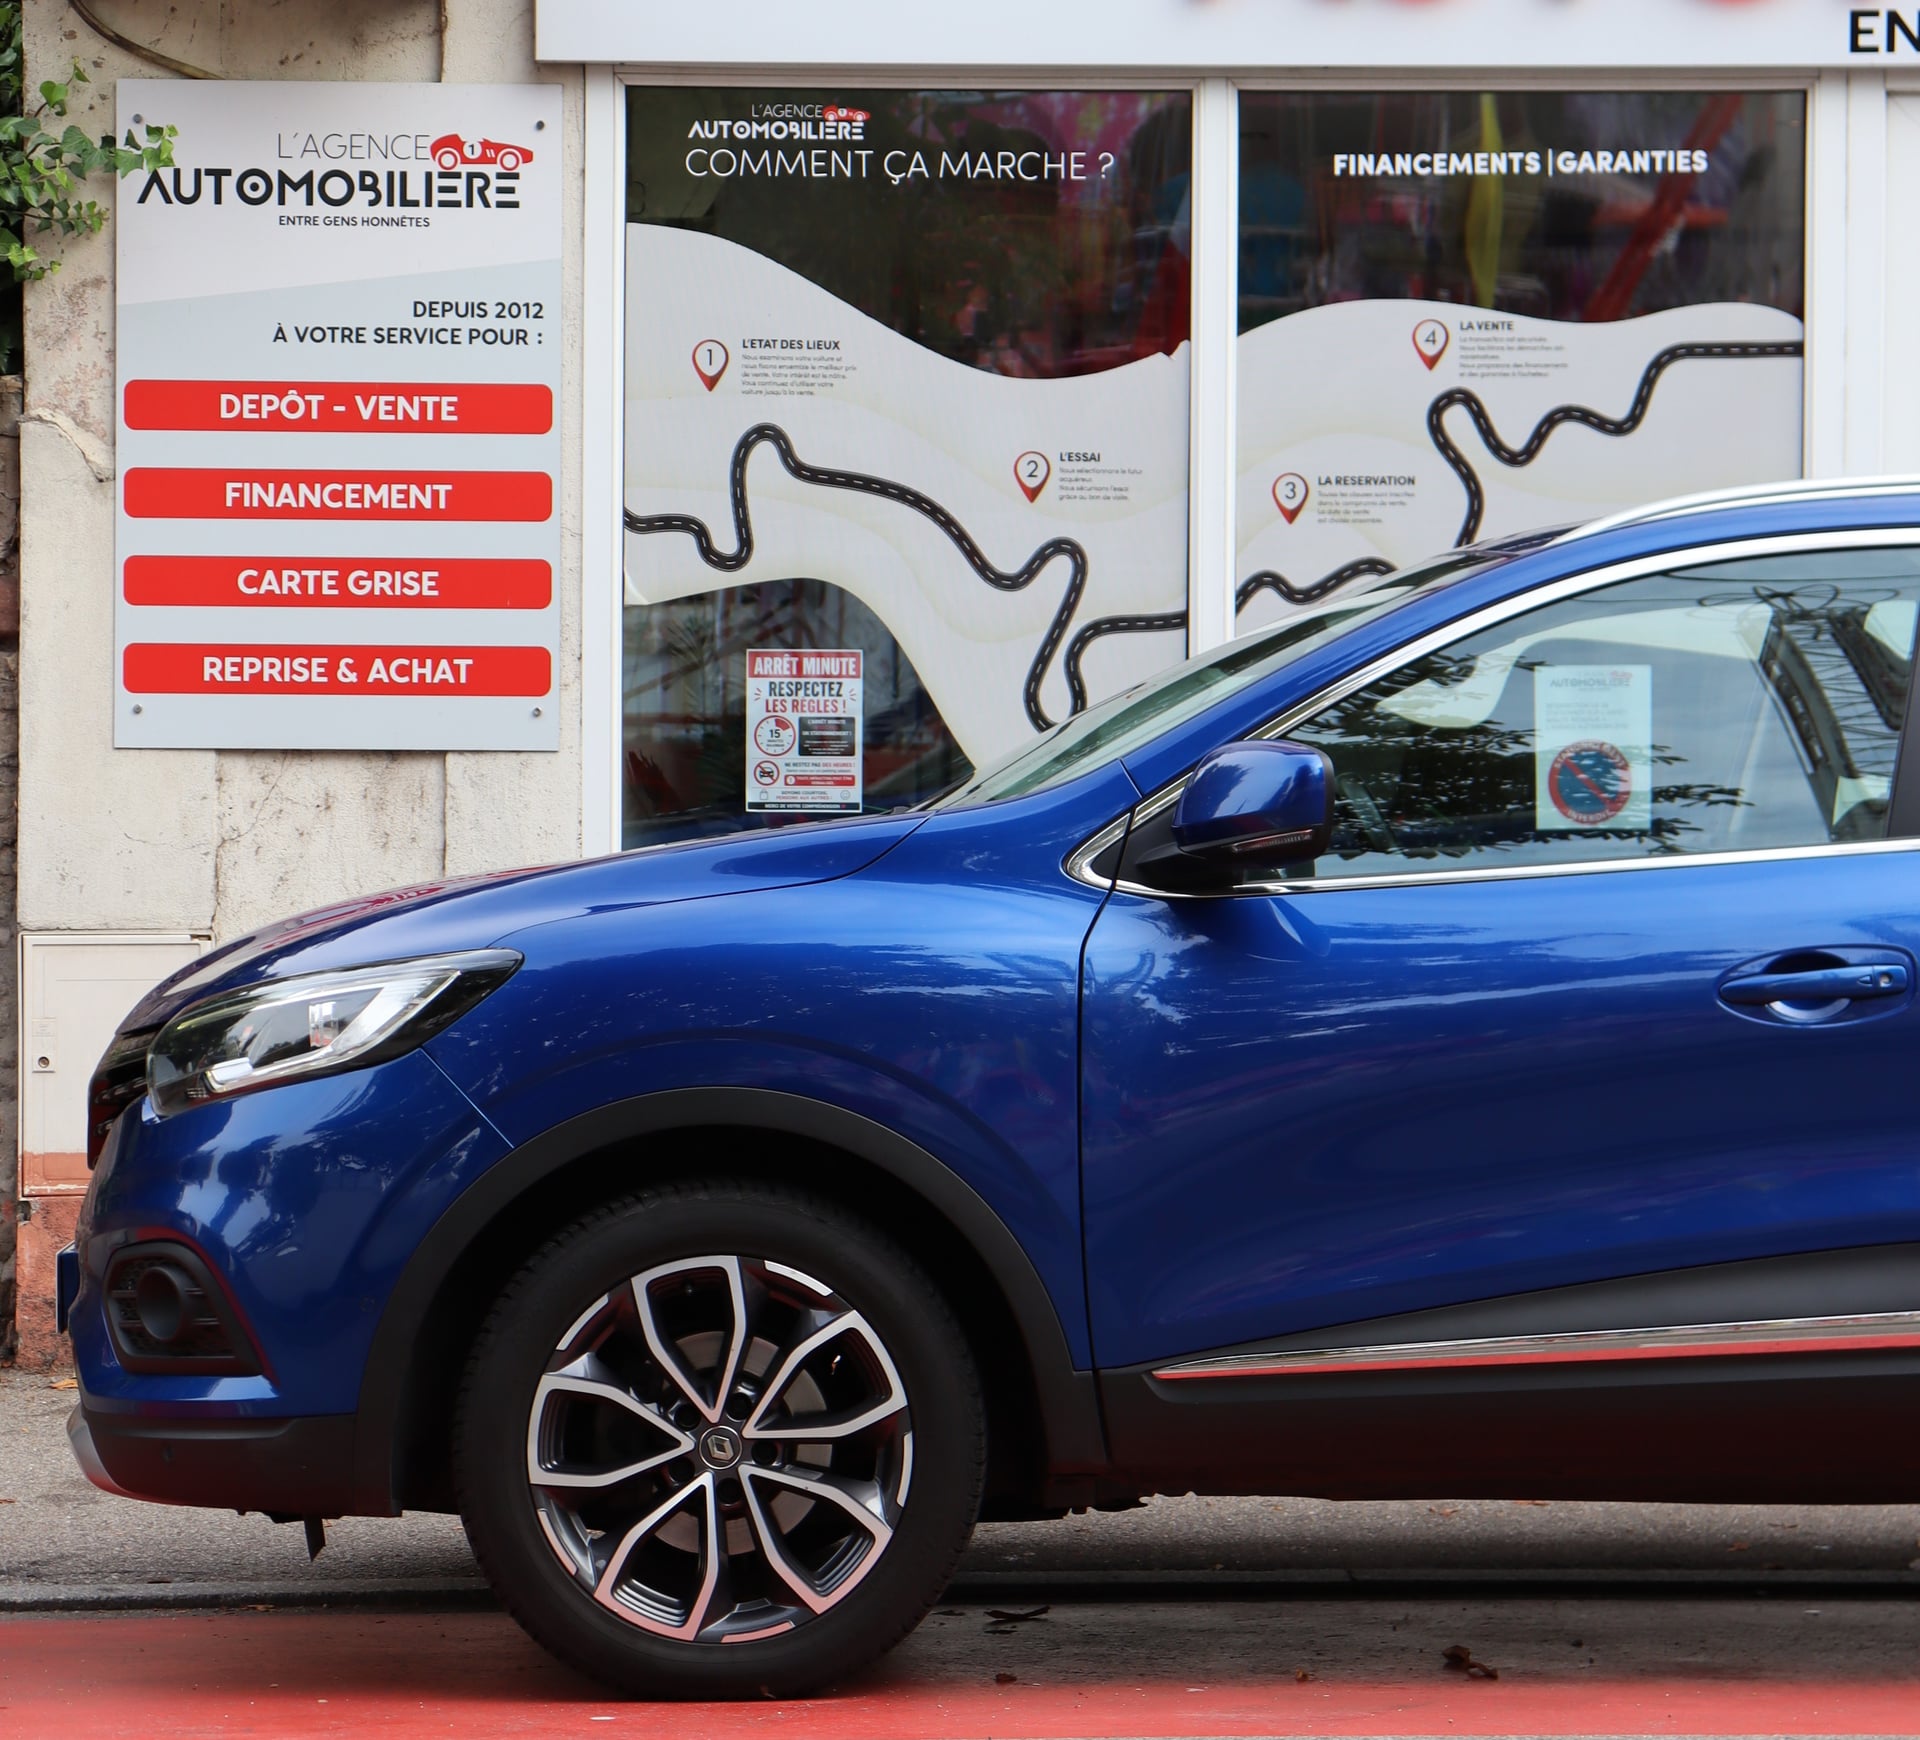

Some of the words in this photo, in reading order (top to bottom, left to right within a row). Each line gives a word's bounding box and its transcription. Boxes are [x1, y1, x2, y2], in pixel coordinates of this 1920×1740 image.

[752, 104, 823, 117] L'AGENCE
[278, 132, 431, 160] L'AGENCE
[685, 148, 874, 178] COMMENT
[884, 150, 930, 185] ÇA
[939, 151, 1087, 179] MARCHE
[1098, 153, 1115, 180] ?
[1333, 152, 1541, 176] FINANCEMENTS
[1556, 150, 1708, 174] GARANTIES
[279, 215, 320, 227] ENTRE
[323, 216, 358, 227] GENS
[361, 215, 430, 228] HONNÊTES
[414, 301, 489, 319] DEPUIS
[495, 301, 544, 319] 2012
[273, 323, 288, 343] À
[295, 326, 367, 344] VOTRE
[373, 327, 462, 344] SERVICE
[469, 328, 529, 345] POUR
[1460, 321, 1474, 330] LA
[1477, 321, 1514, 330] VENTE
[742, 339, 777, 349] L'ETAT
[780, 340, 803, 349] DES
[807, 340, 840, 350] LIEUX
[1425, 330, 1437, 345] 4
[707, 349, 712, 366] 1
[220, 390, 325, 420] DEPÔT
[355, 395, 458, 422] VENTE
[1060, 452, 1100, 462] L'ESSAI
[1027, 460, 1038, 477] 2
[1318, 476, 1332, 485] LA
[1336, 476, 1415, 485] RESERVATION
[225, 482, 452, 509] FINANCEMENT
[1285, 481, 1296, 500] 3
[237, 569, 339, 595] CARTE
[347, 570, 439, 597] GRISE
[204, 656, 328, 682] REPRISE
[336, 658, 358, 682] &
[367, 658, 473, 683] ACHAT
[754, 654, 799, 674] ARRÊT
[803, 657, 856, 675] MINUTE
[769, 682, 843, 697] RESPECTEZ
[766, 699, 787, 713] LES
[770, 729, 780, 738] 15
